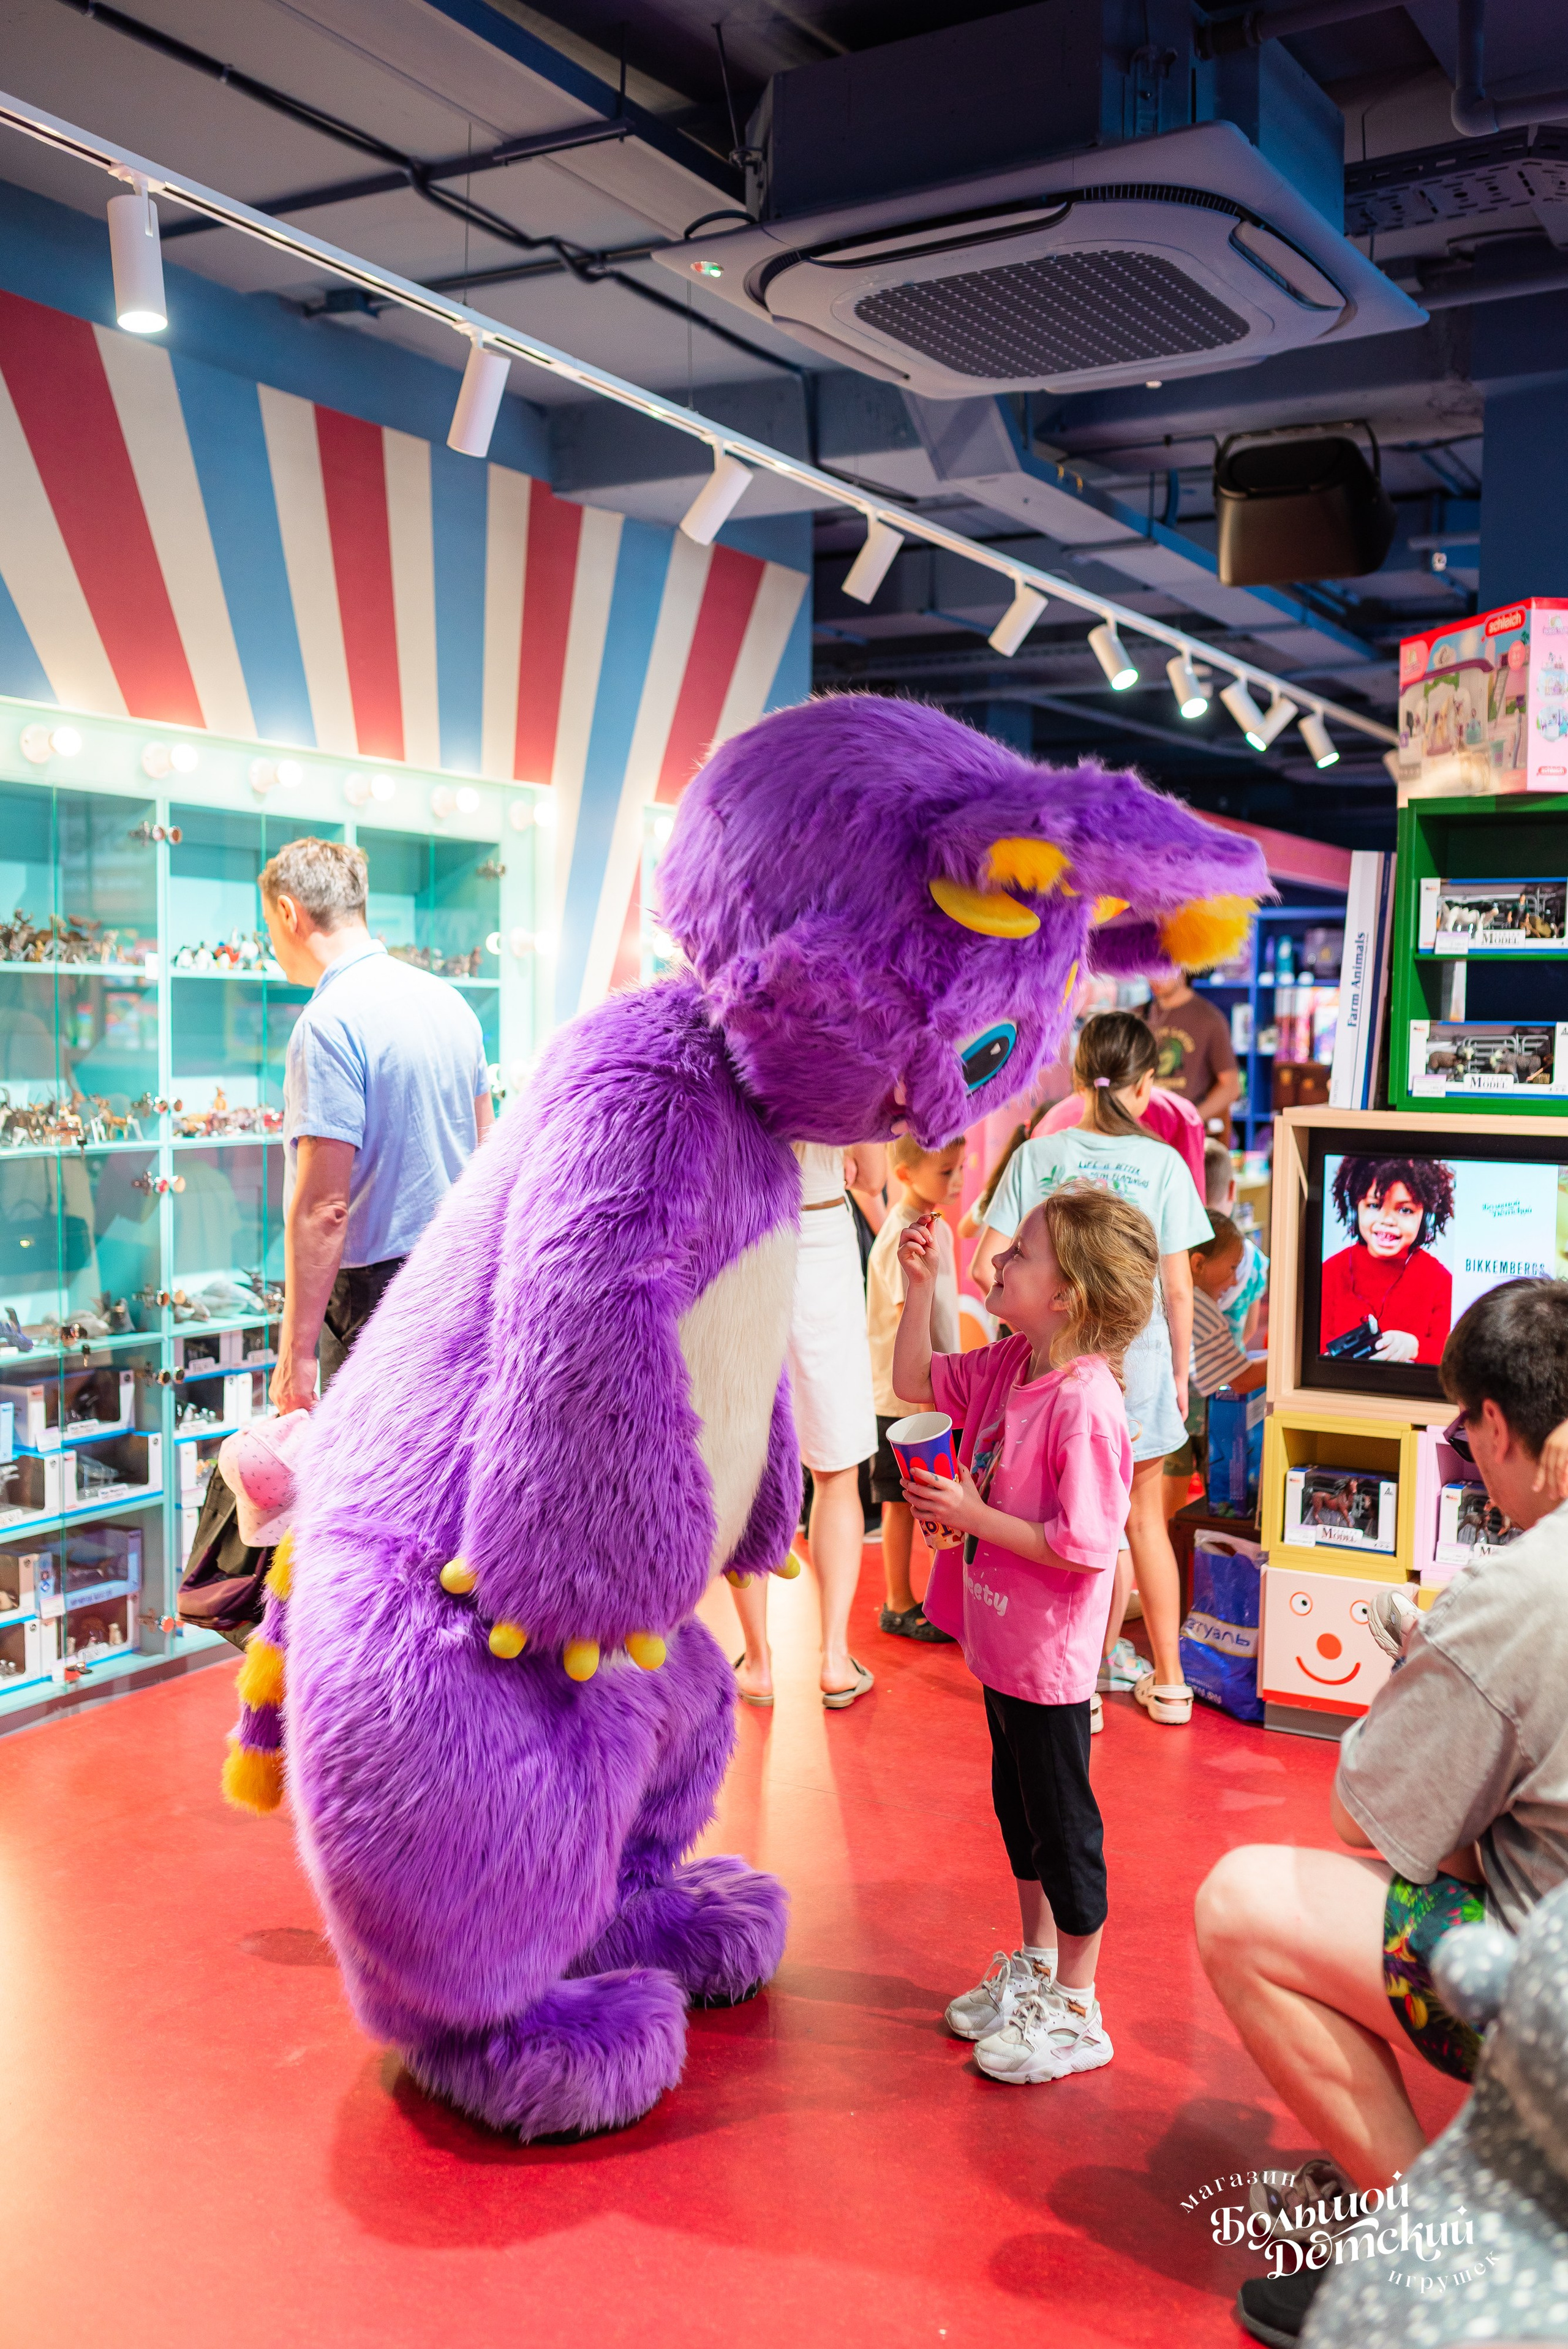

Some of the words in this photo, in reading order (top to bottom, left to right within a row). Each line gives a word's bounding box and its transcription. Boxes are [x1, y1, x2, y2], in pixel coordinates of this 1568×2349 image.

[1351, 932, 1366, 989] Animals
[1347, 994, 1360, 1027] Farm
[1466, 1259, 1545, 1275] BIKKEMBERGS
